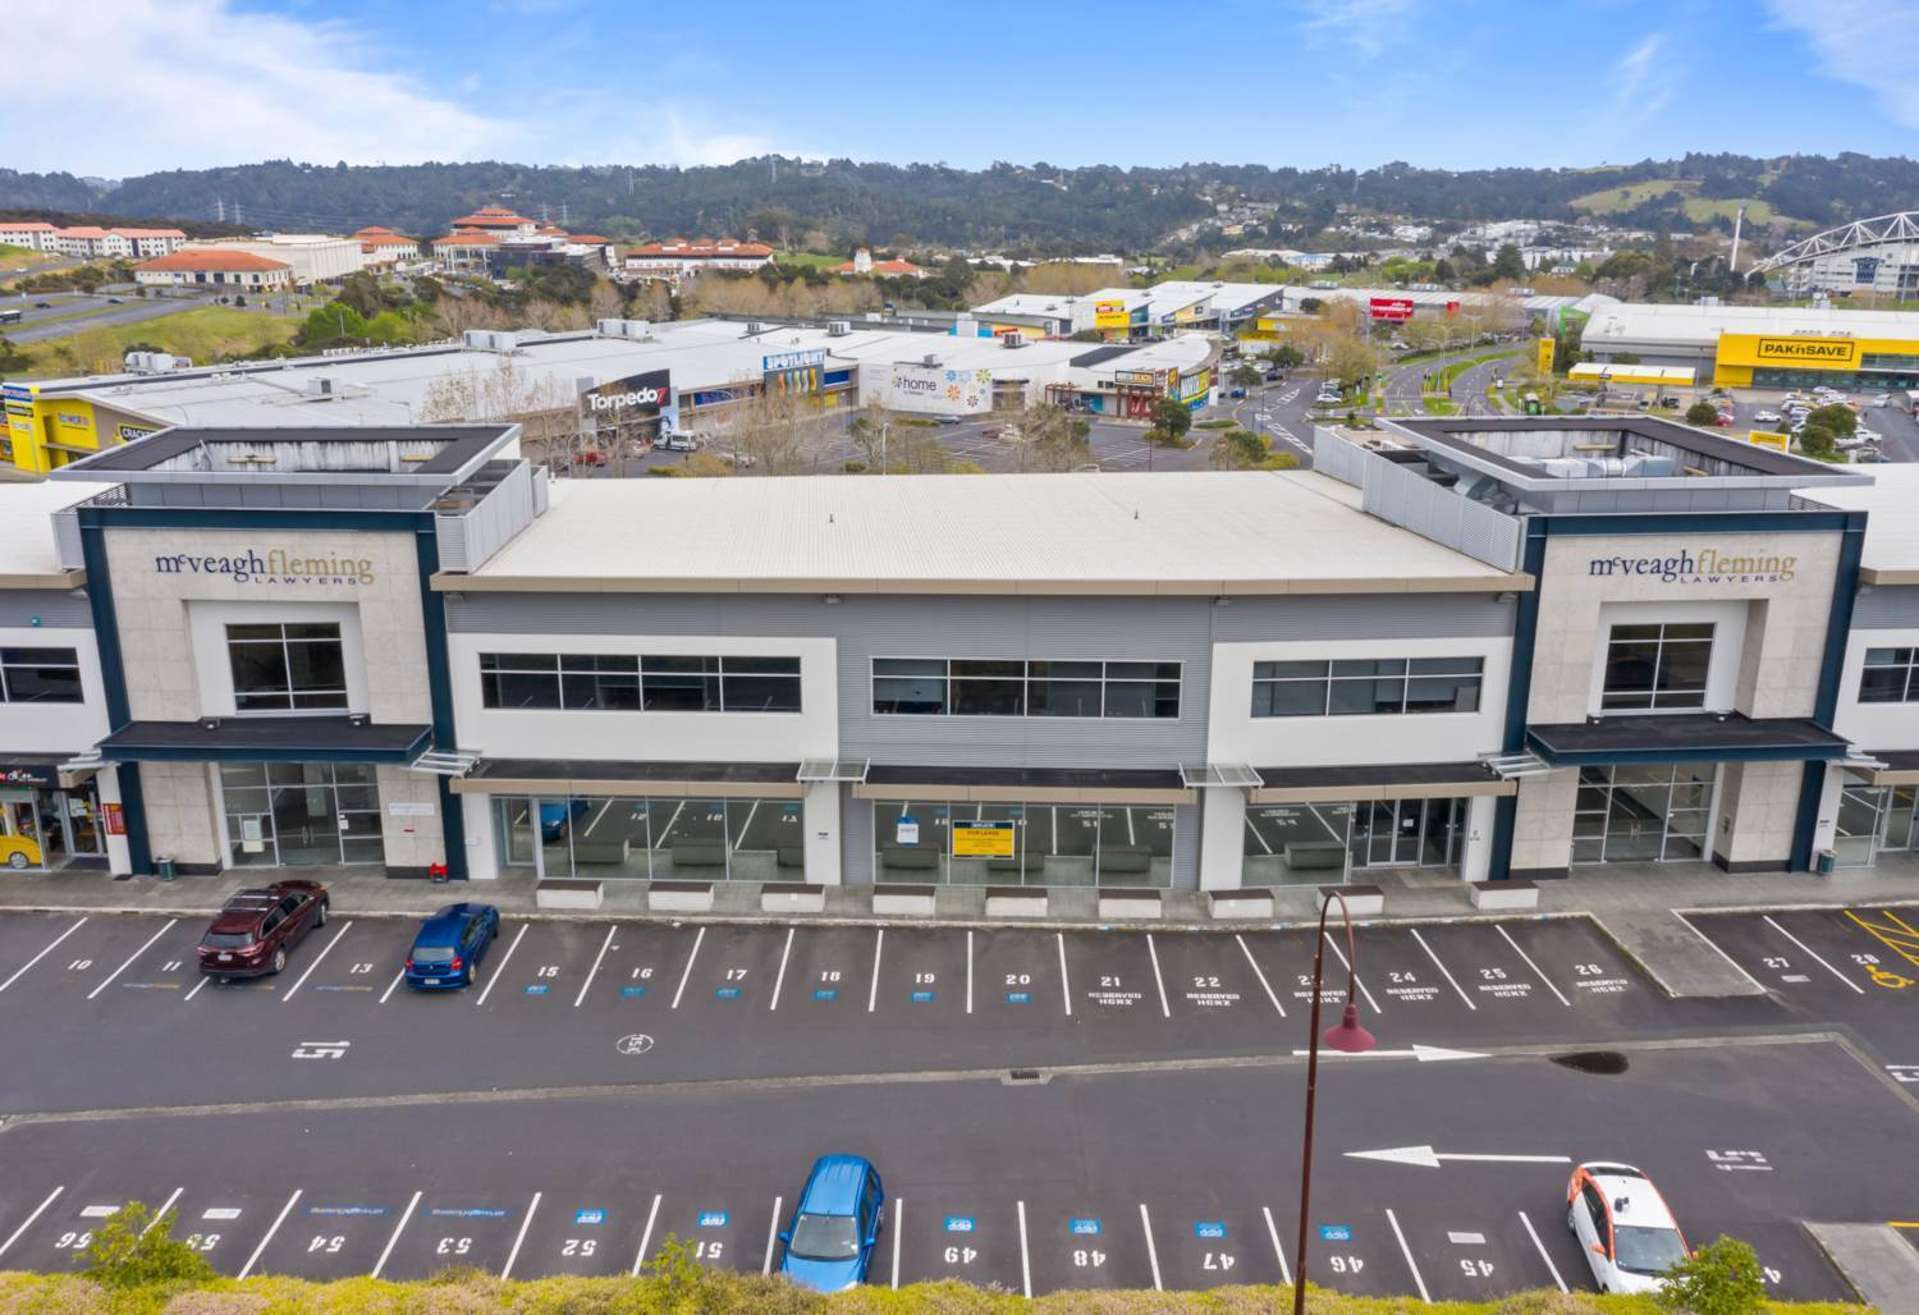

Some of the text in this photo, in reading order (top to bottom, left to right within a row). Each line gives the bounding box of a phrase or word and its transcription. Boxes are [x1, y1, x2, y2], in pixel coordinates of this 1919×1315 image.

[903, 377, 937, 391] home
[587, 387, 666, 411] Torpedo7
[254, 576, 356, 585] LAWYERS
[1680, 575, 1777, 584] LAWYERS
[68, 959, 93, 970] 10
[162, 961, 182, 972] 11
[350, 963, 373, 974] 13
[1763, 957, 1790, 968] 27
[537, 966, 559, 977] 15
[632, 967, 653, 979] 16
[726, 969, 748, 981] 17
[1480, 968, 1507, 980] 25
[1574, 963, 1603, 975] 26
[821, 971, 841, 982] 18
[915, 973, 935, 984] 19
[1005, 974, 1031, 985] 20
[1100, 976, 1121, 987] 21
[1194, 976, 1221, 988] 22
[1389, 971, 1416, 983] 24
[1186, 992, 1240, 1000] RESERVED
[55, 1232, 95, 1249] 56
[308, 1236, 346, 1252] 54
[436, 1238, 472, 1254] 53
[562, 1239, 597, 1256] 52
[695, 1241, 723, 1259] 51
[945, 1247, 977, 1263] 49
[1074, 1250, 1106, 1267] 48
[1203, 1253, 1235, 1270] 47
[1330, 1256, 1364, 1273] 46
[1460, 1259, 1494, 1277] 45
